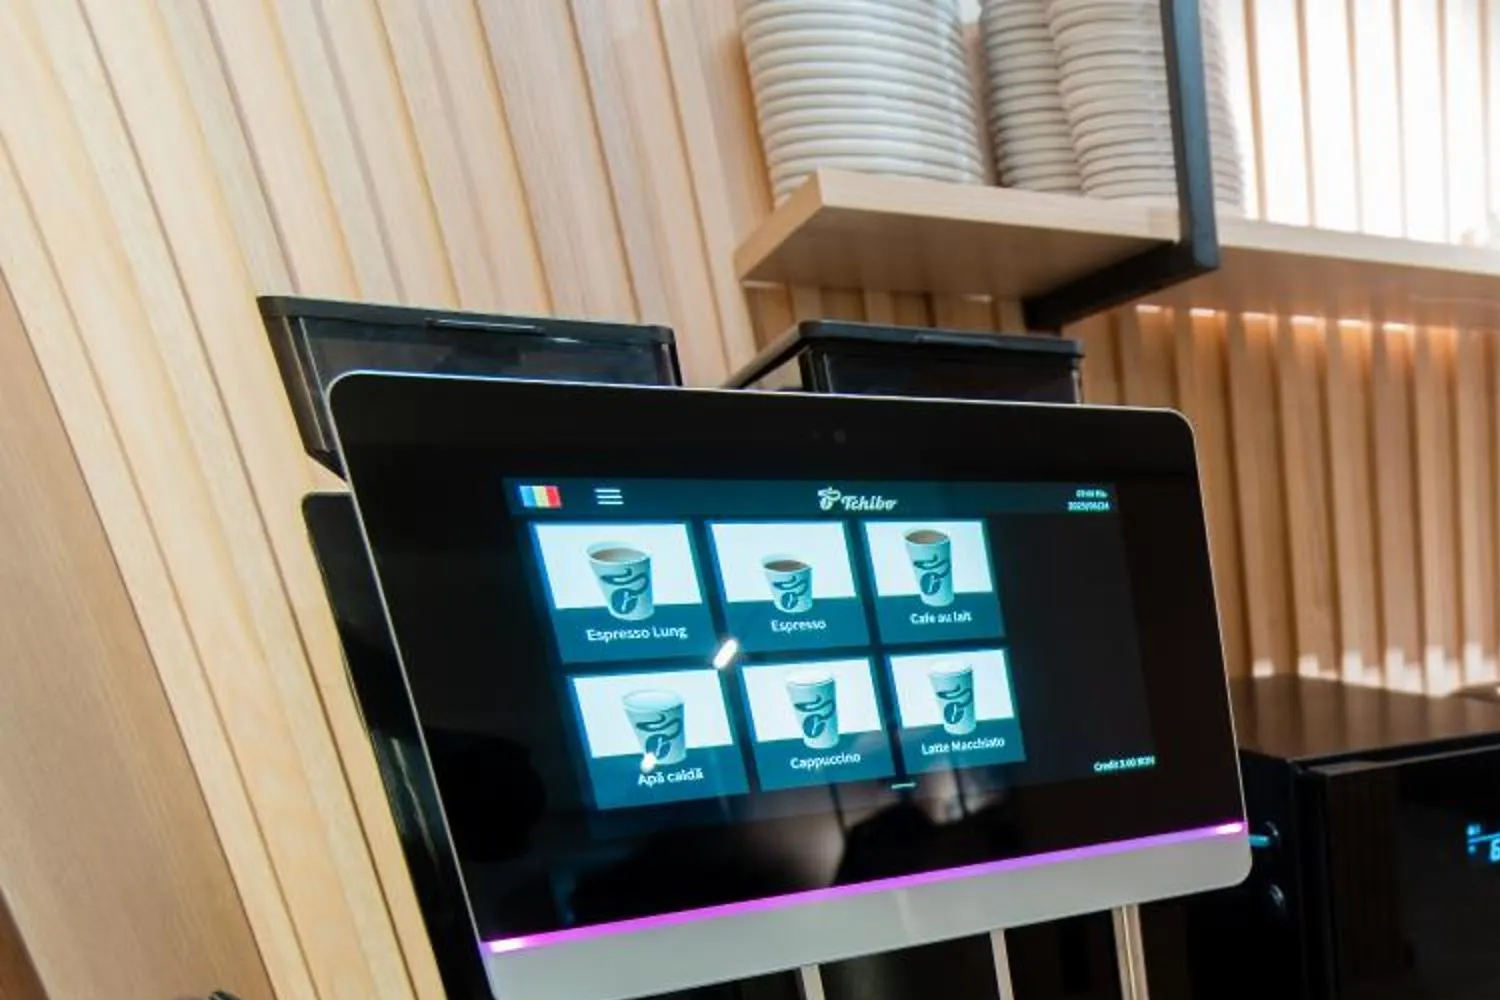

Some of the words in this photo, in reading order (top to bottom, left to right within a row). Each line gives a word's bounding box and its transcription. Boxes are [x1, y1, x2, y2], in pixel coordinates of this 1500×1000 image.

[841, 495, 898, 511] Tchibo
[937, 612, 952, 624] au
[953, 609, 973, 622] lait
[771, 619, 827, 633] Espresso
[586, 628, 650, 643] Espresso
[652, 626, 689, 640] Lung
[921, 742, 949, 756] Latte
[951, 736, 1006, 753] Macchiato
[789, 751, 861, 770] Cappuccino
